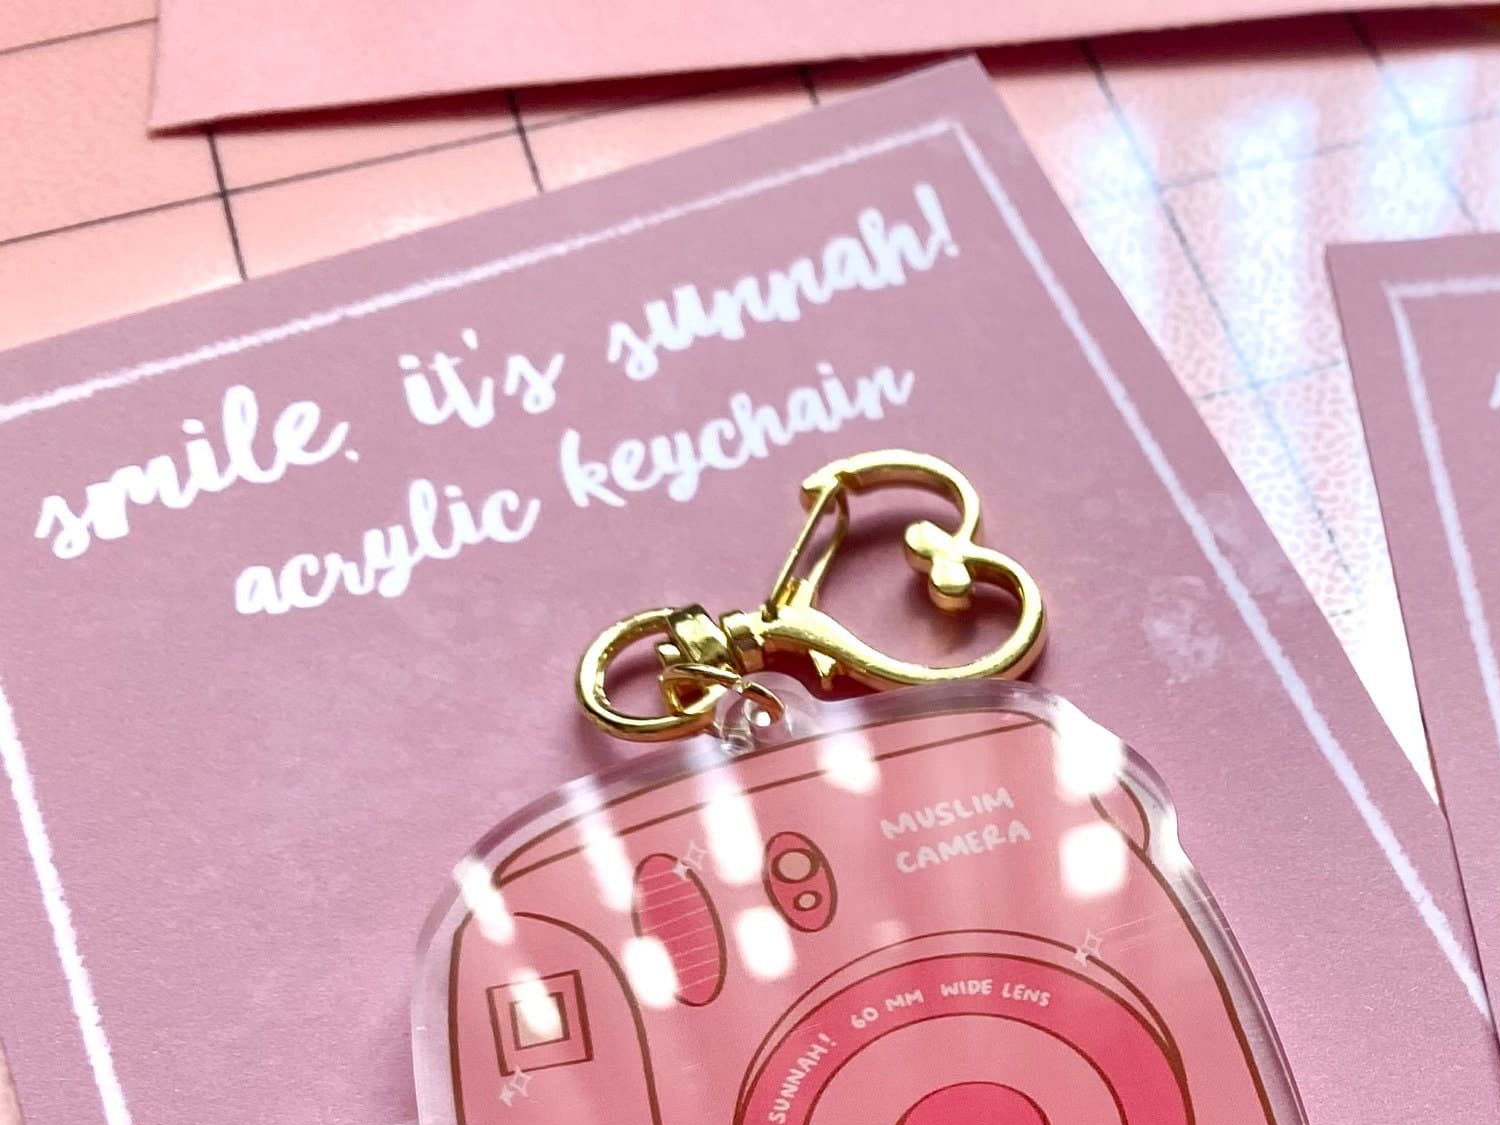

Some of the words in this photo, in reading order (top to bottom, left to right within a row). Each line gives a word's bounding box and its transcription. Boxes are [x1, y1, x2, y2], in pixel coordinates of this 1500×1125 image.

[400, 329, 563, 428] it's
[607, 182, 959, 381] sunnah!
[234, 478, 540, 614] acrylic
[560, 361, 914, 508] keychain
[880, 787, 1016, 840] MUSLIM
[895, 819, 1031, 875] CAMERA
[768, 1032, 838, 1125] SUNNAH!
[850, 1006, 880, 1029] 60
[884, 987, 925, 1012] MM
[940, 977, 993, 998] WIDE
[1002, 982, 1053, 1008] LENS
